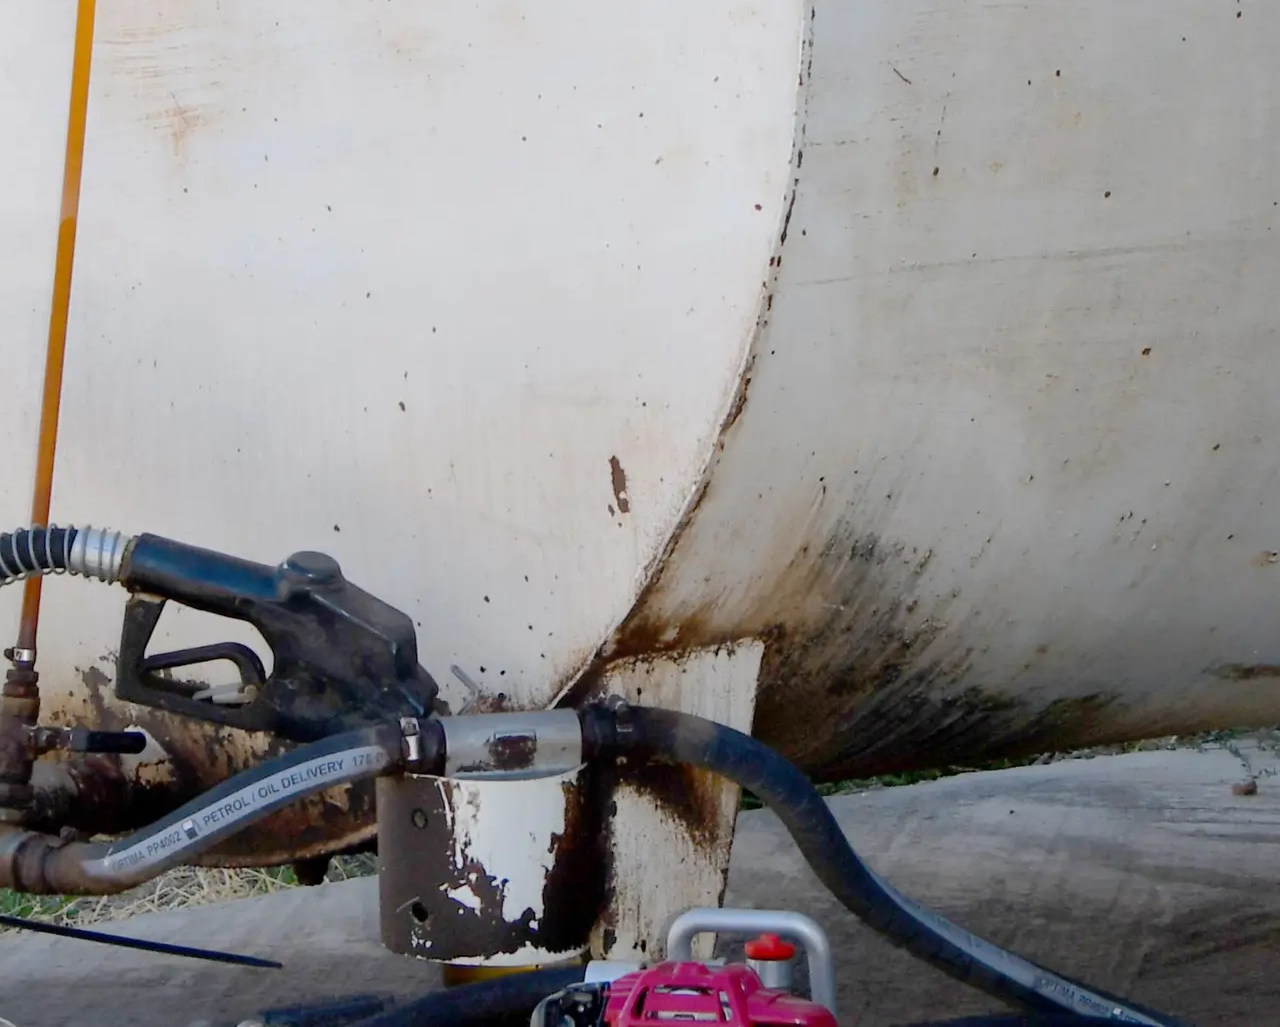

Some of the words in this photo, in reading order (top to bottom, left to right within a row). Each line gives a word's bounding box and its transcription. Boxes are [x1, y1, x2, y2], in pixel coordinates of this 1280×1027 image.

[203, 796, 250, 826] PETROL
[257, 784, 280, 799] OIL
[281, 759, 344, 789] DELIVERY
